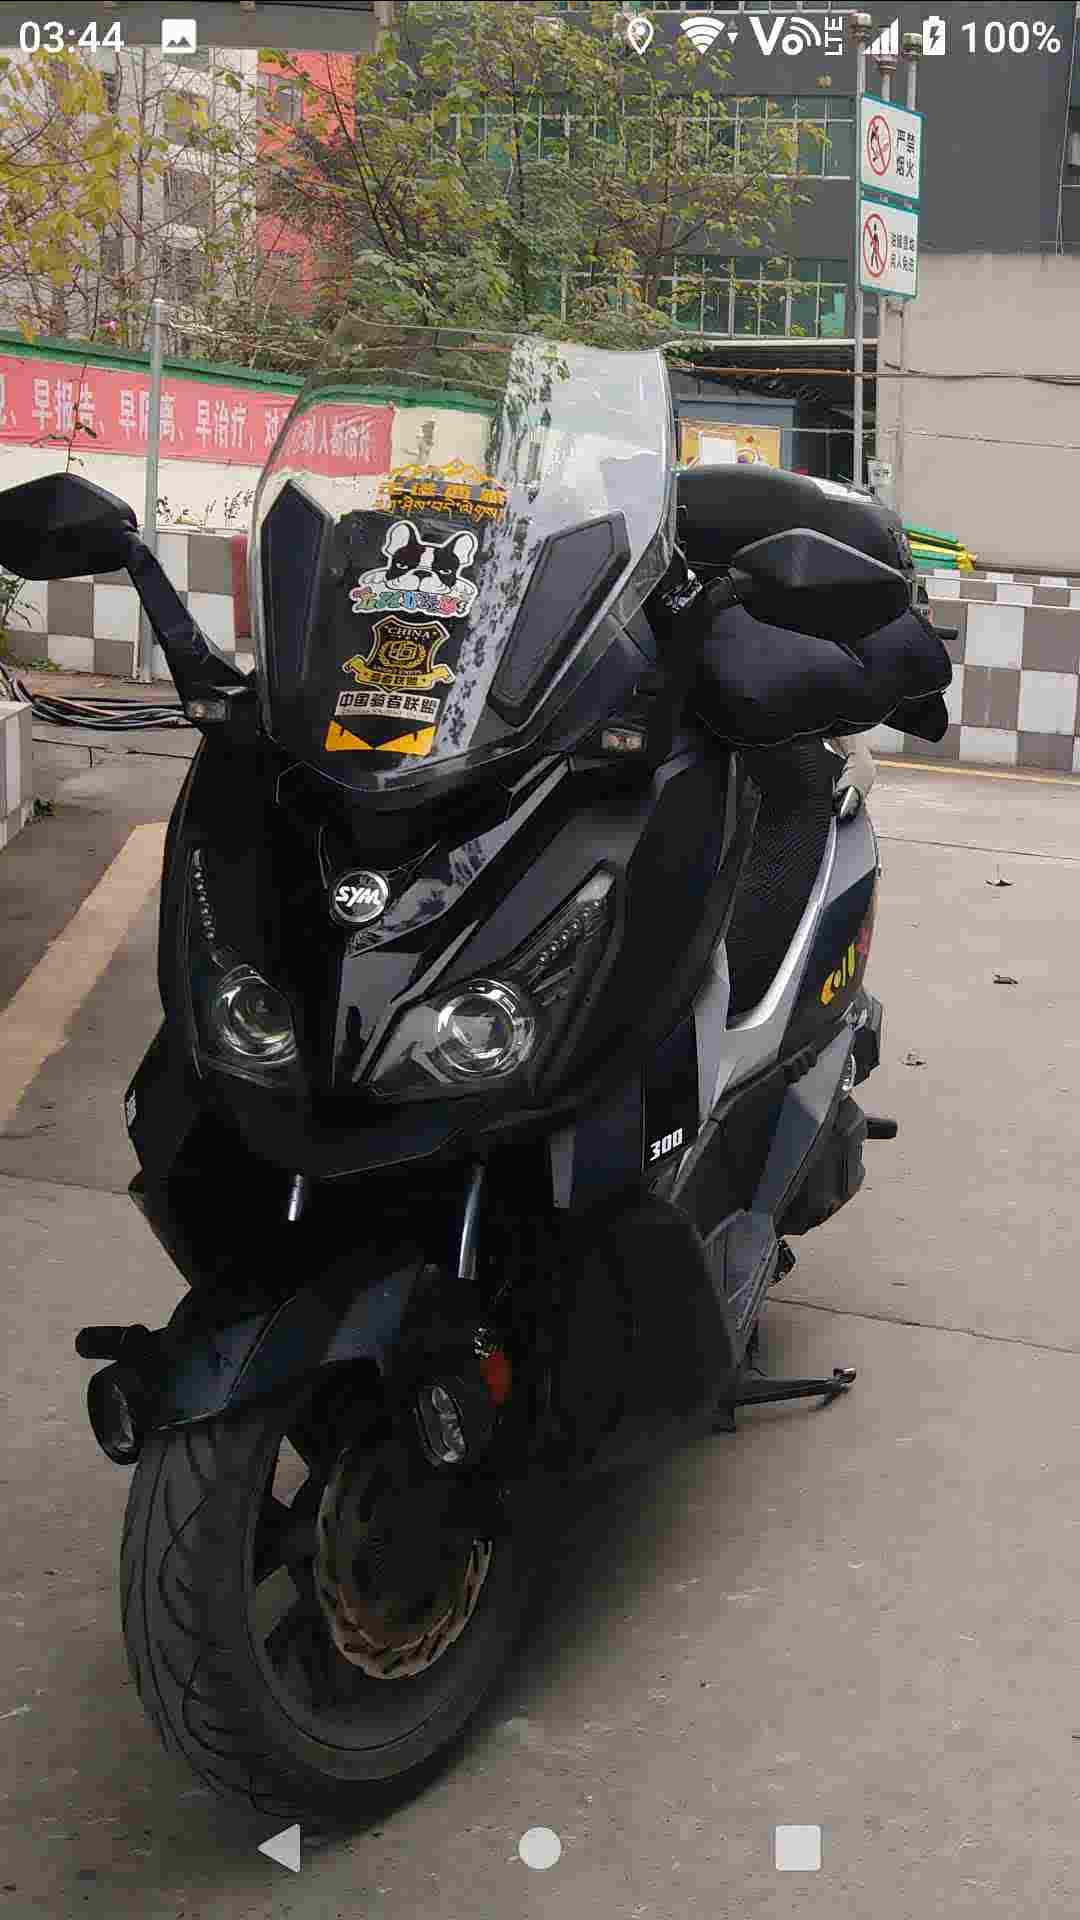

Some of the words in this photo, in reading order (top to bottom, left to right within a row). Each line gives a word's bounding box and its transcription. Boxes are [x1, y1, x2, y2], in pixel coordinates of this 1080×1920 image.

[896, 128, 915, 154] 严禁
[896, 156, 915, 179] 烟火
[387, 626, 430, 640] CHINA
[339, 691, 435, 714] 中国骑者联盟
[336, 886, 381, 907] SYM
[650, 1128, 683, 1161] 300
